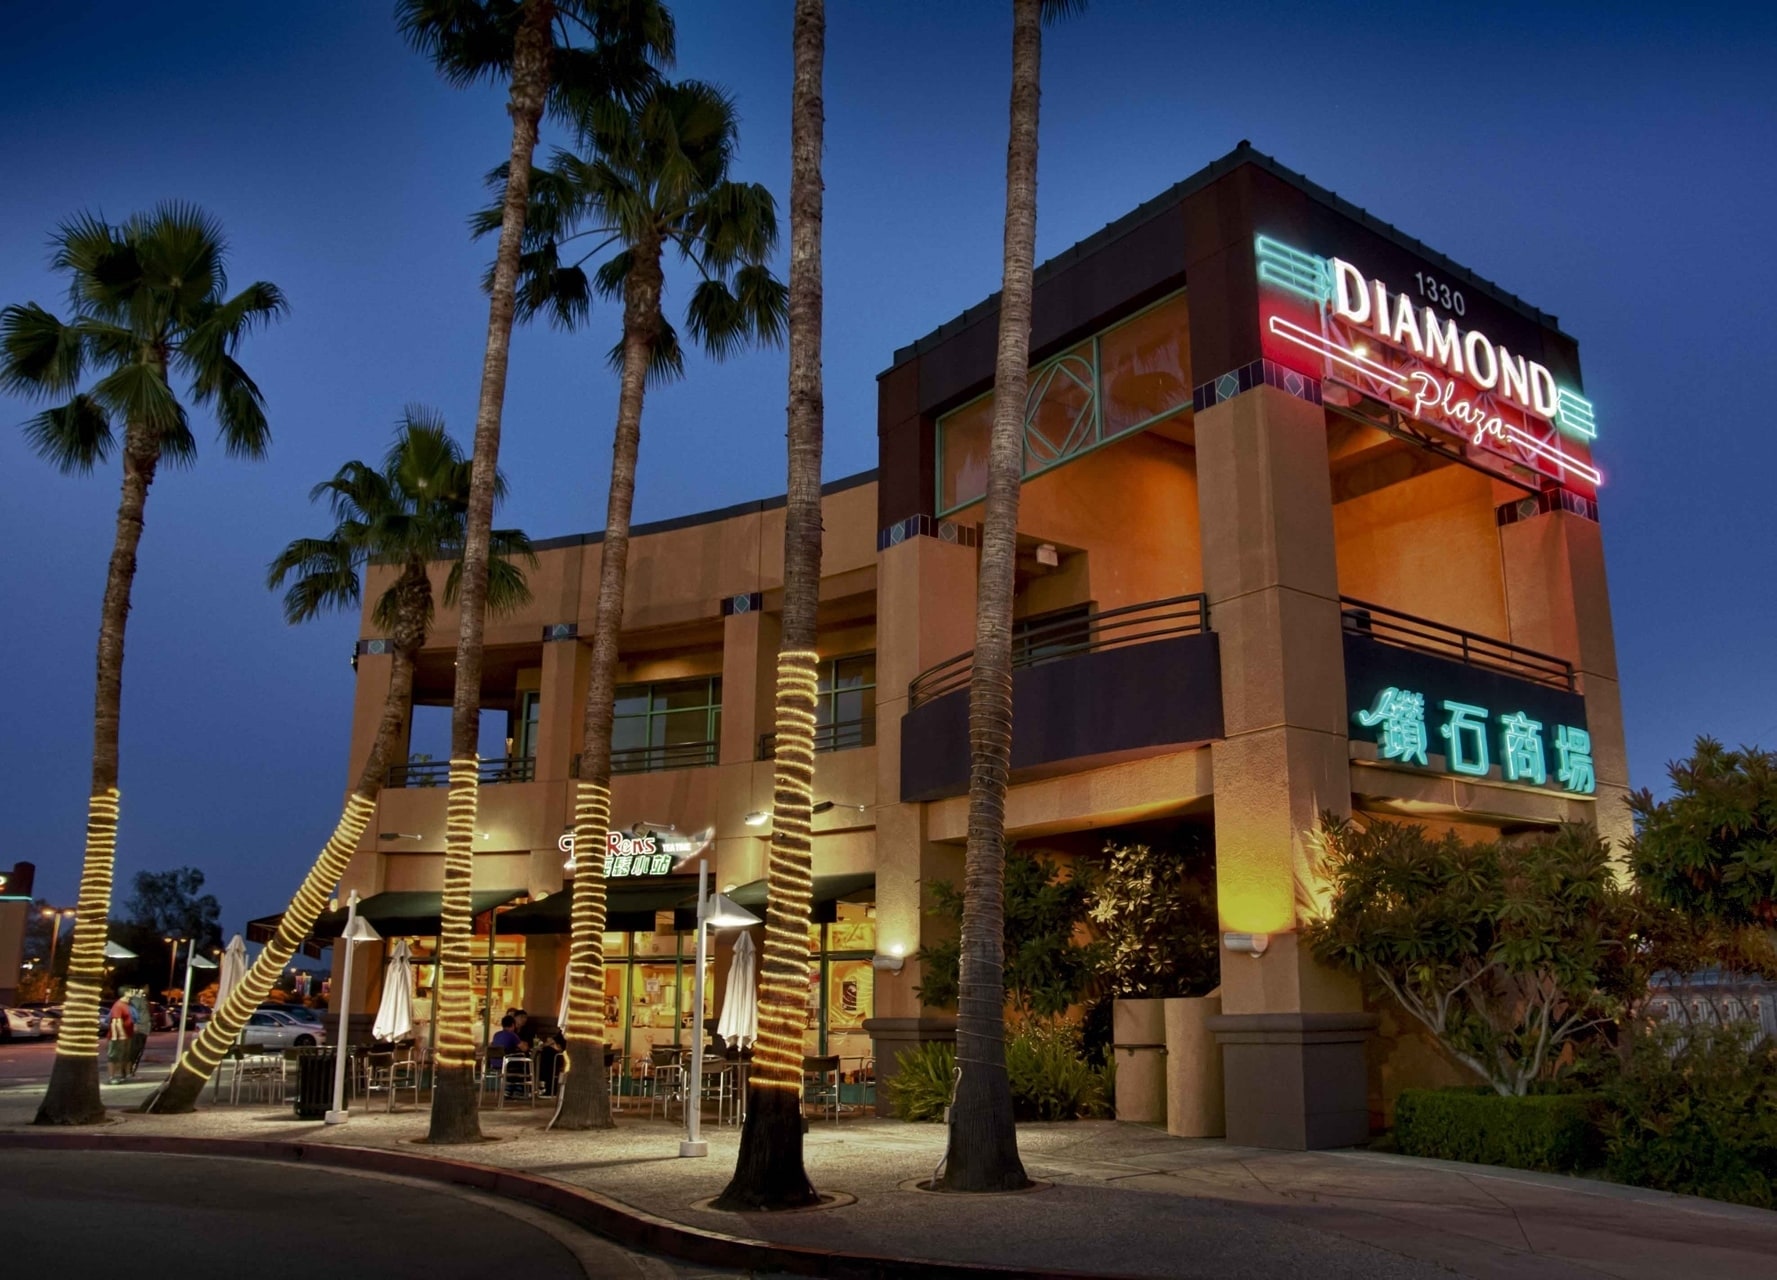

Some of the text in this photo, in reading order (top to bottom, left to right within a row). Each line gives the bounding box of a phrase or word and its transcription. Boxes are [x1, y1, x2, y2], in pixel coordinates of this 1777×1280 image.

[1333, 257, 1558, 418] DIAMOND
[1415, 271, 1465, 316] 1330
[1410, 371, 1506, 445] Plaza
[1359, 686, 1596, 794] 鑽石商場
